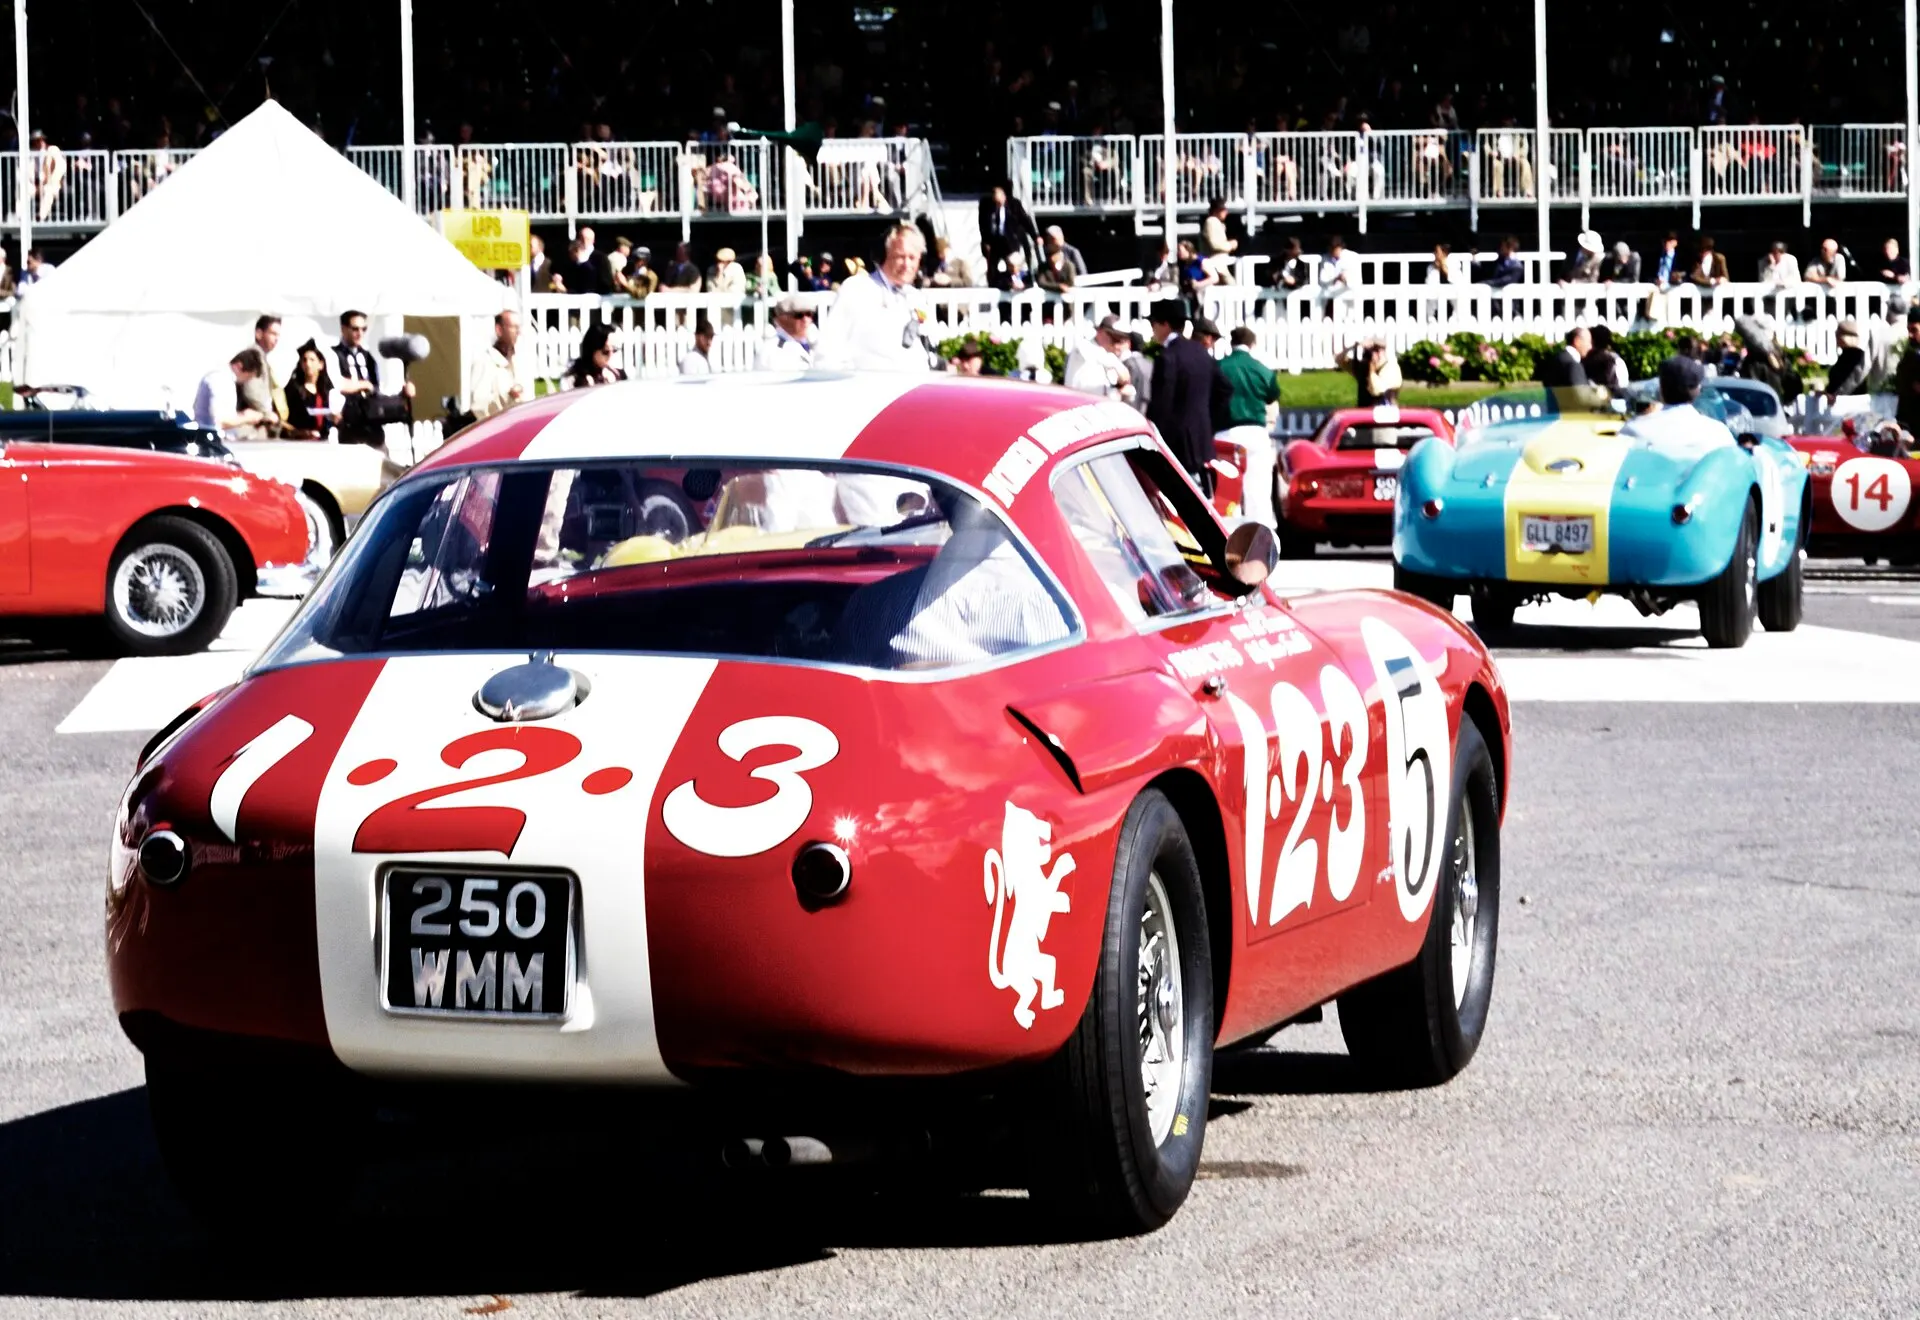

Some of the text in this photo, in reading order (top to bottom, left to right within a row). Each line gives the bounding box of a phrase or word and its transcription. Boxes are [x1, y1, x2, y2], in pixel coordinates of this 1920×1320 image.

[1845, 473, 1893, 511] 14
[1526, 524, 1589, 542] GLL 8497
[1384, 656, 1435, 896] 5
[410, 877, 547, 940] 250
[411, 947, 545, 1011] WMM
